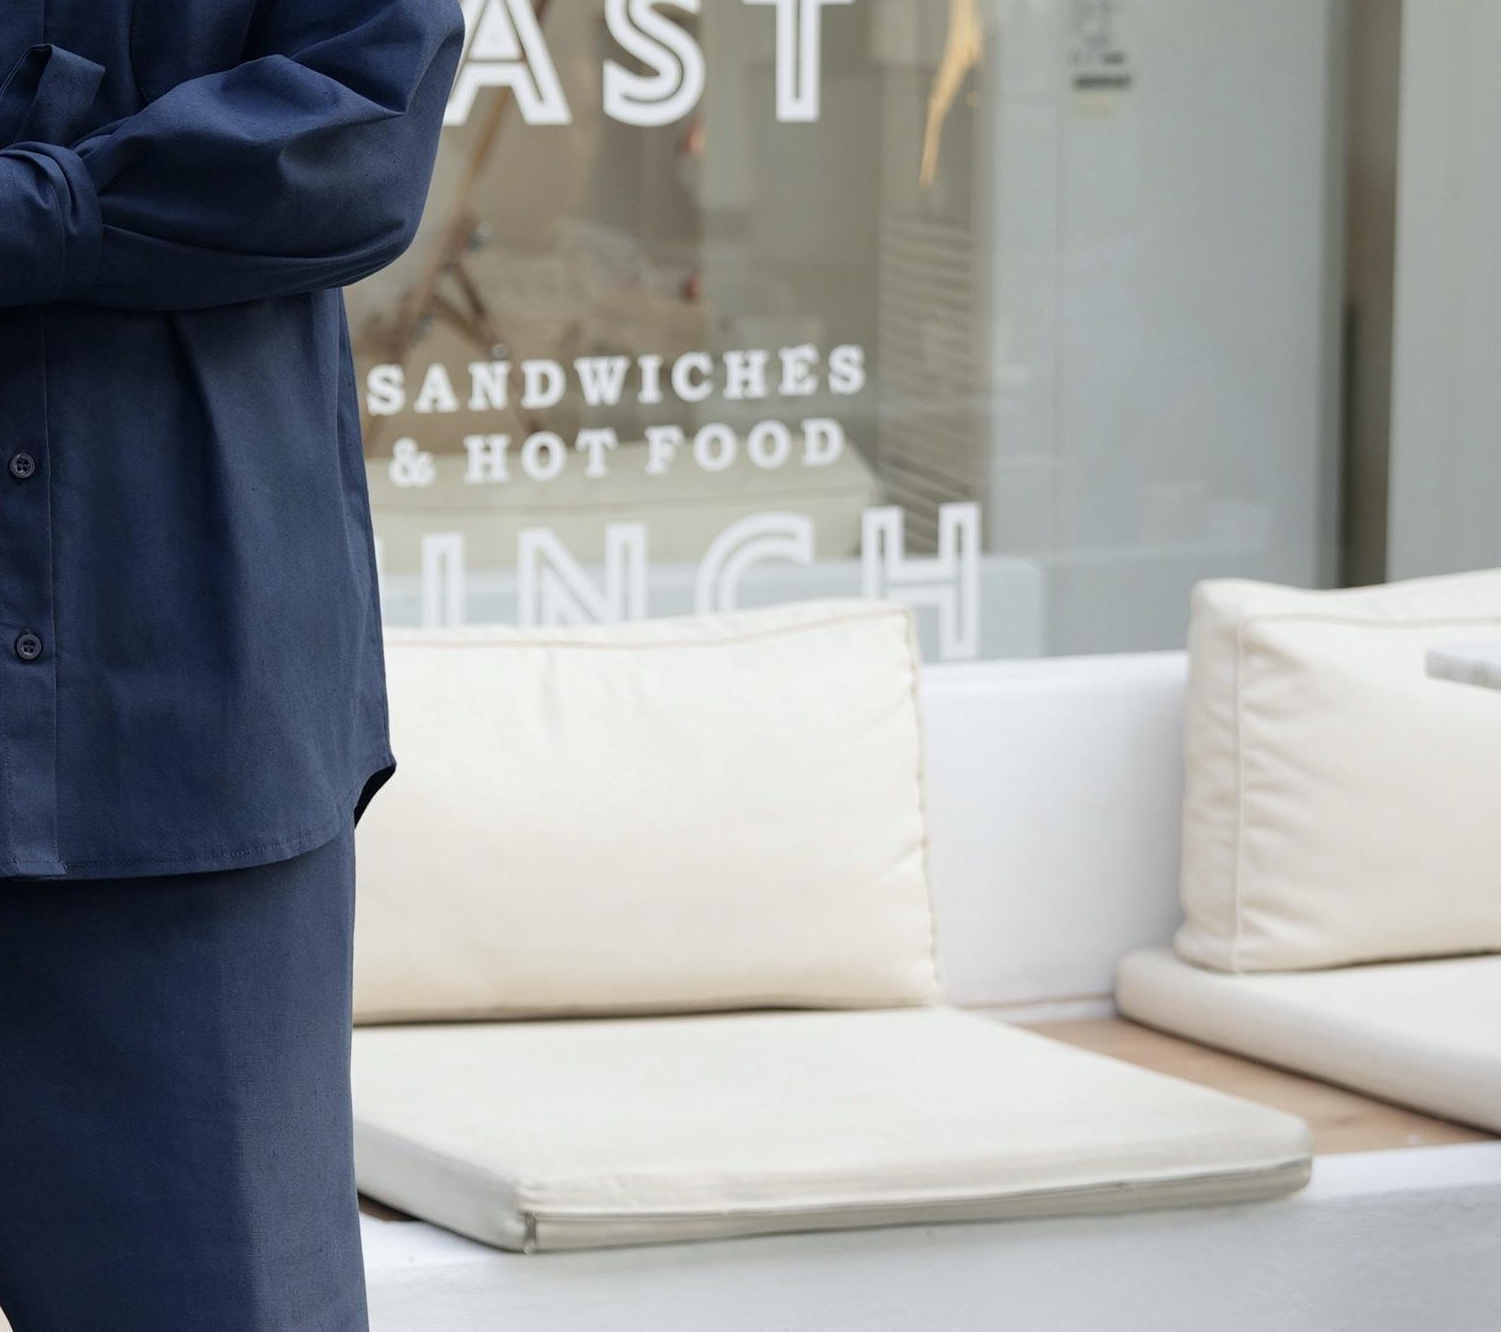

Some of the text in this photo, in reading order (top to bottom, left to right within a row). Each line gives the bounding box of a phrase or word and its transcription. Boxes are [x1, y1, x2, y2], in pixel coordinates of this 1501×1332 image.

[367, 343, 867, 416] SANDWICHES
[388, 417, 845, 488] & HOT FOOD
[375, 500, 982, 661] NCH
